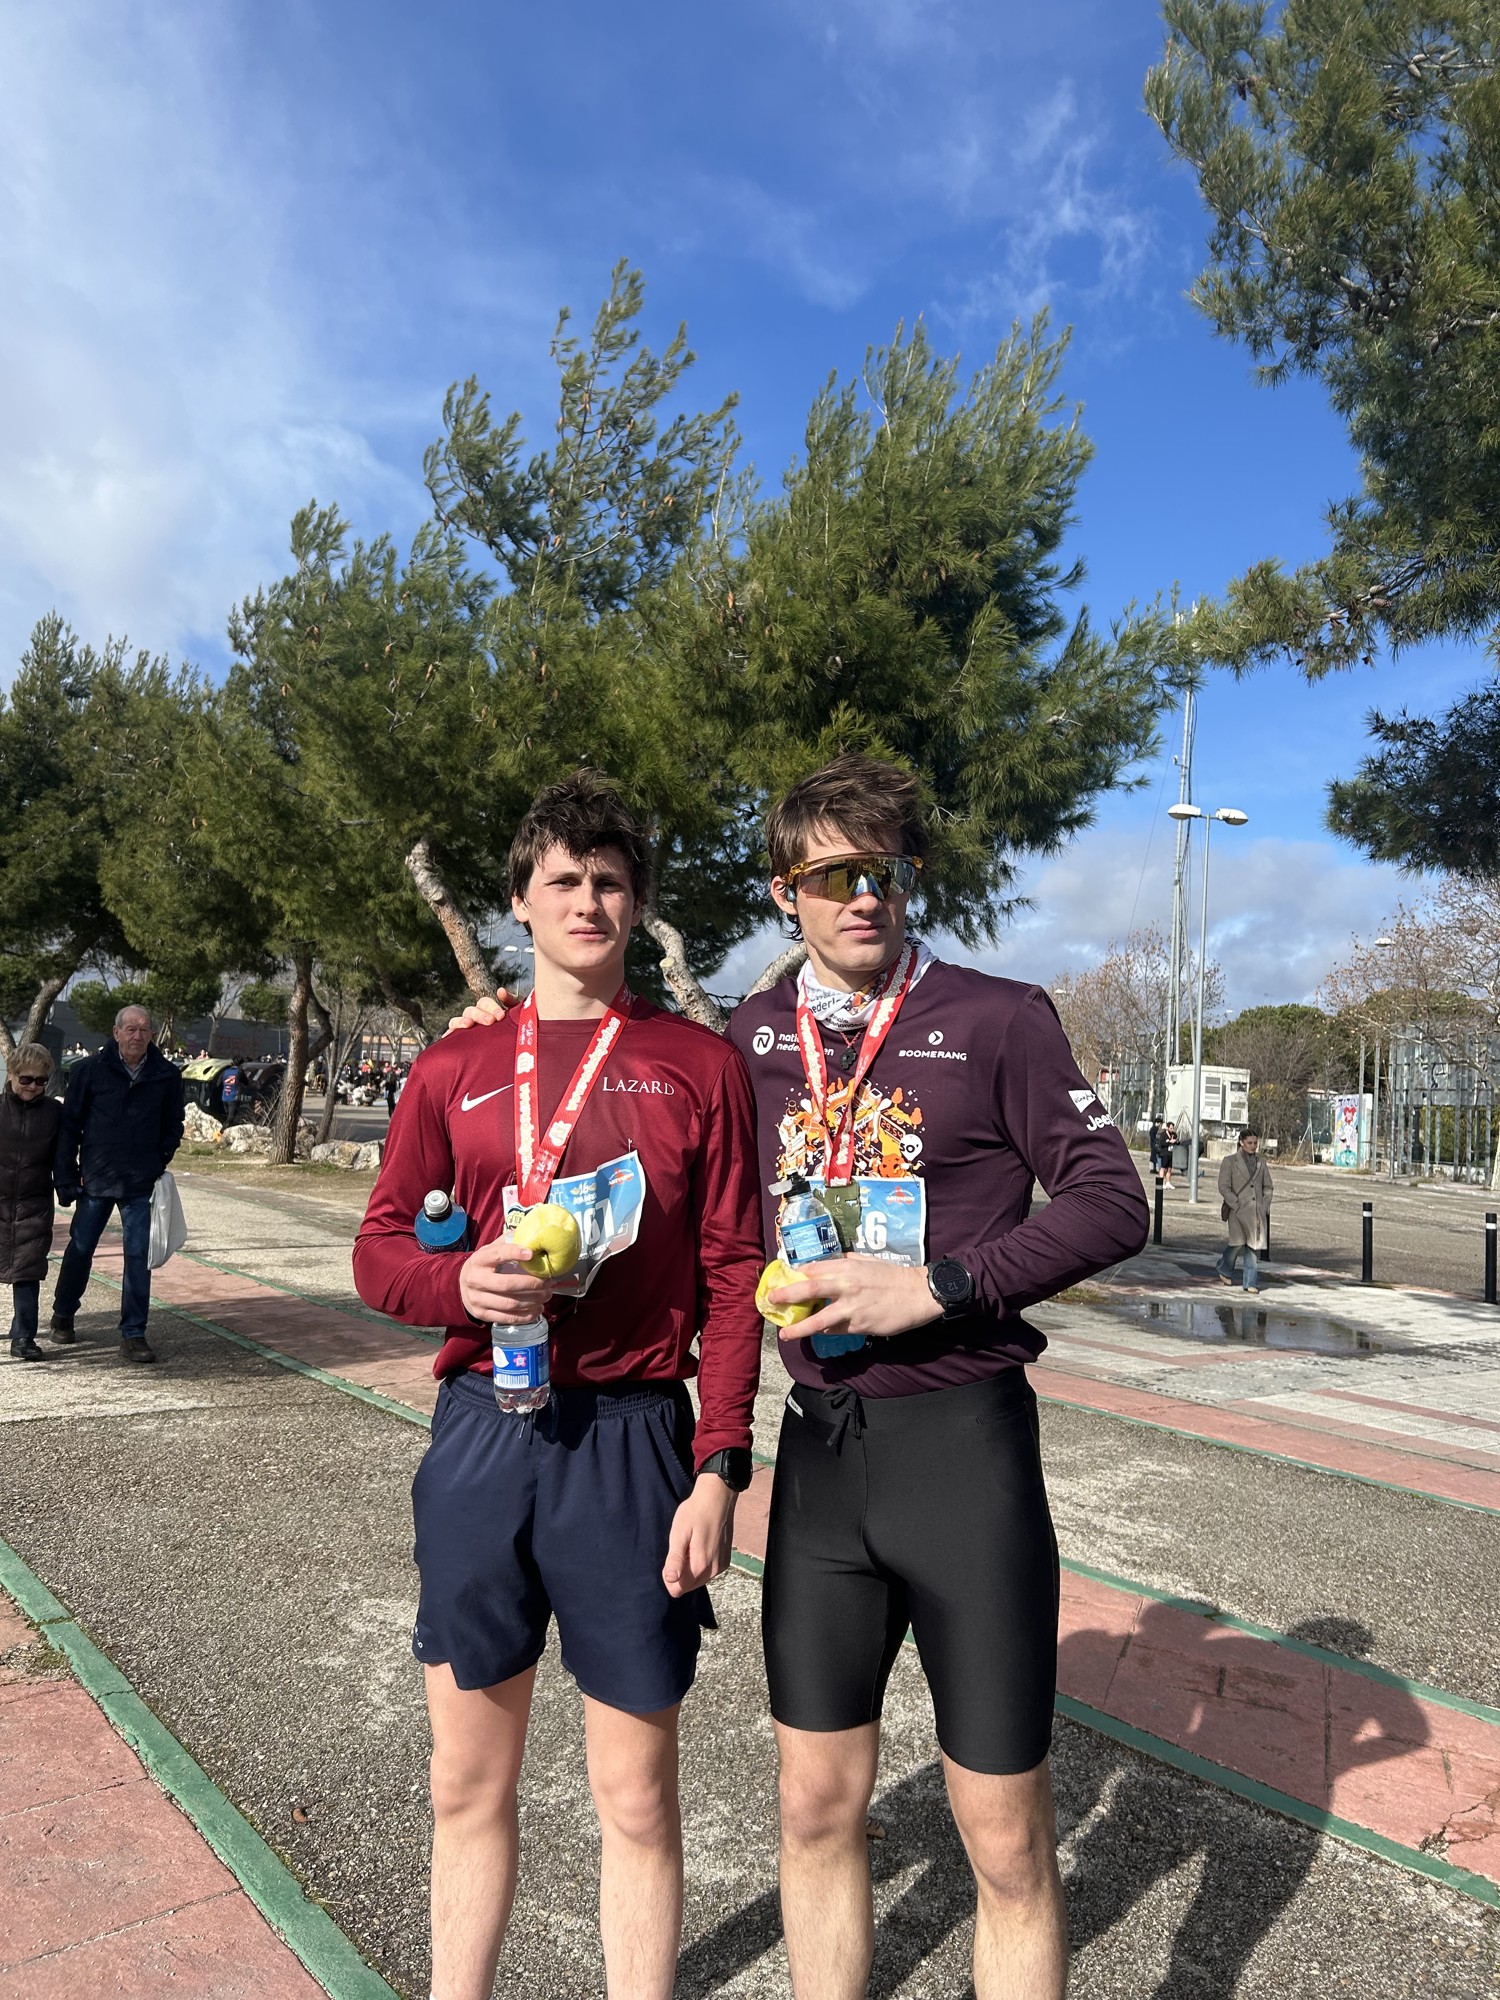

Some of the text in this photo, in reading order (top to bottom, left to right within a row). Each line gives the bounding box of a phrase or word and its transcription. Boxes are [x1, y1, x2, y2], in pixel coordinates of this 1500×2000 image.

[898, 1050, 967, 1061] BOOMERANG
[602, 1076, 675, 1096] LAZARD
[1086, 1113, 1114, 1131] Jeep
